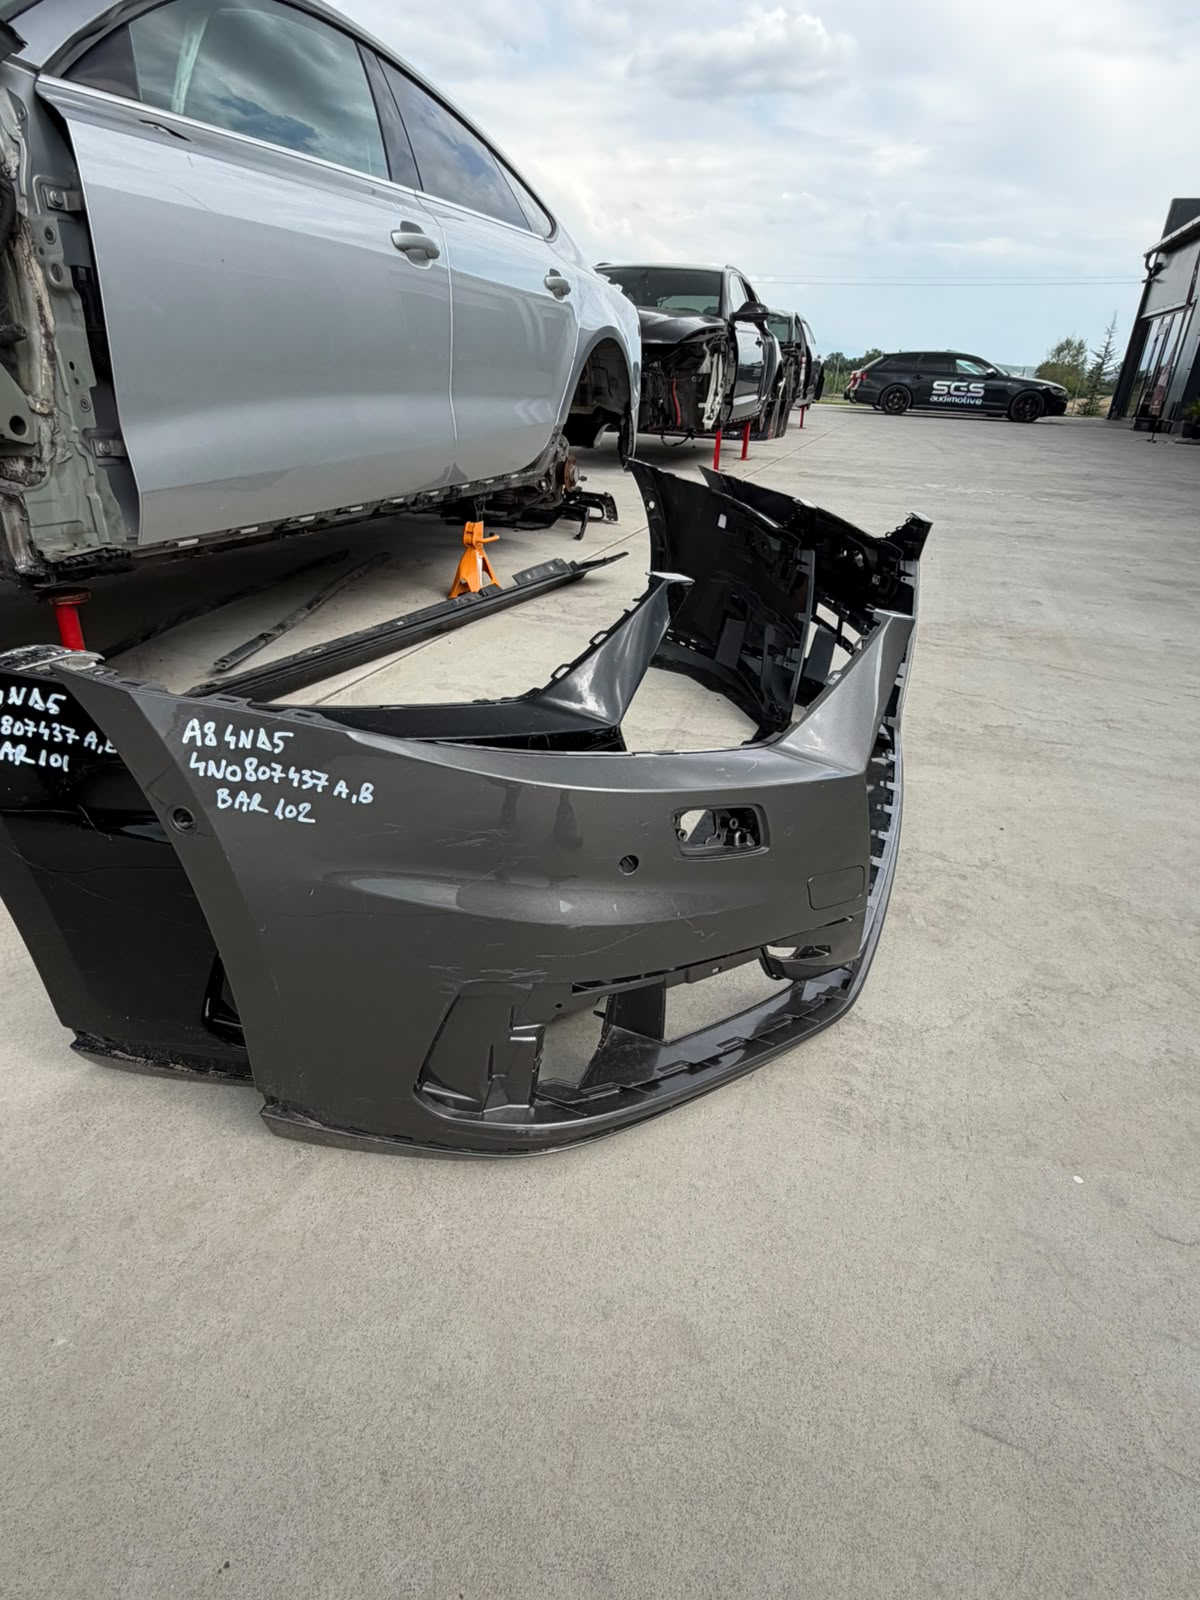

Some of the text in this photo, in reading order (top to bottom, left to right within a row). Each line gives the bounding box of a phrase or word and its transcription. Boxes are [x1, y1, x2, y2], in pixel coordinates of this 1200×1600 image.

[929, 394, 983, 405] audimotive
[931, 380, 986, 397] SGS
[182, 718, 217, 747] A8
[38, 749, 69, 772] 101
[216, 788, 316, 823] BAR 102
